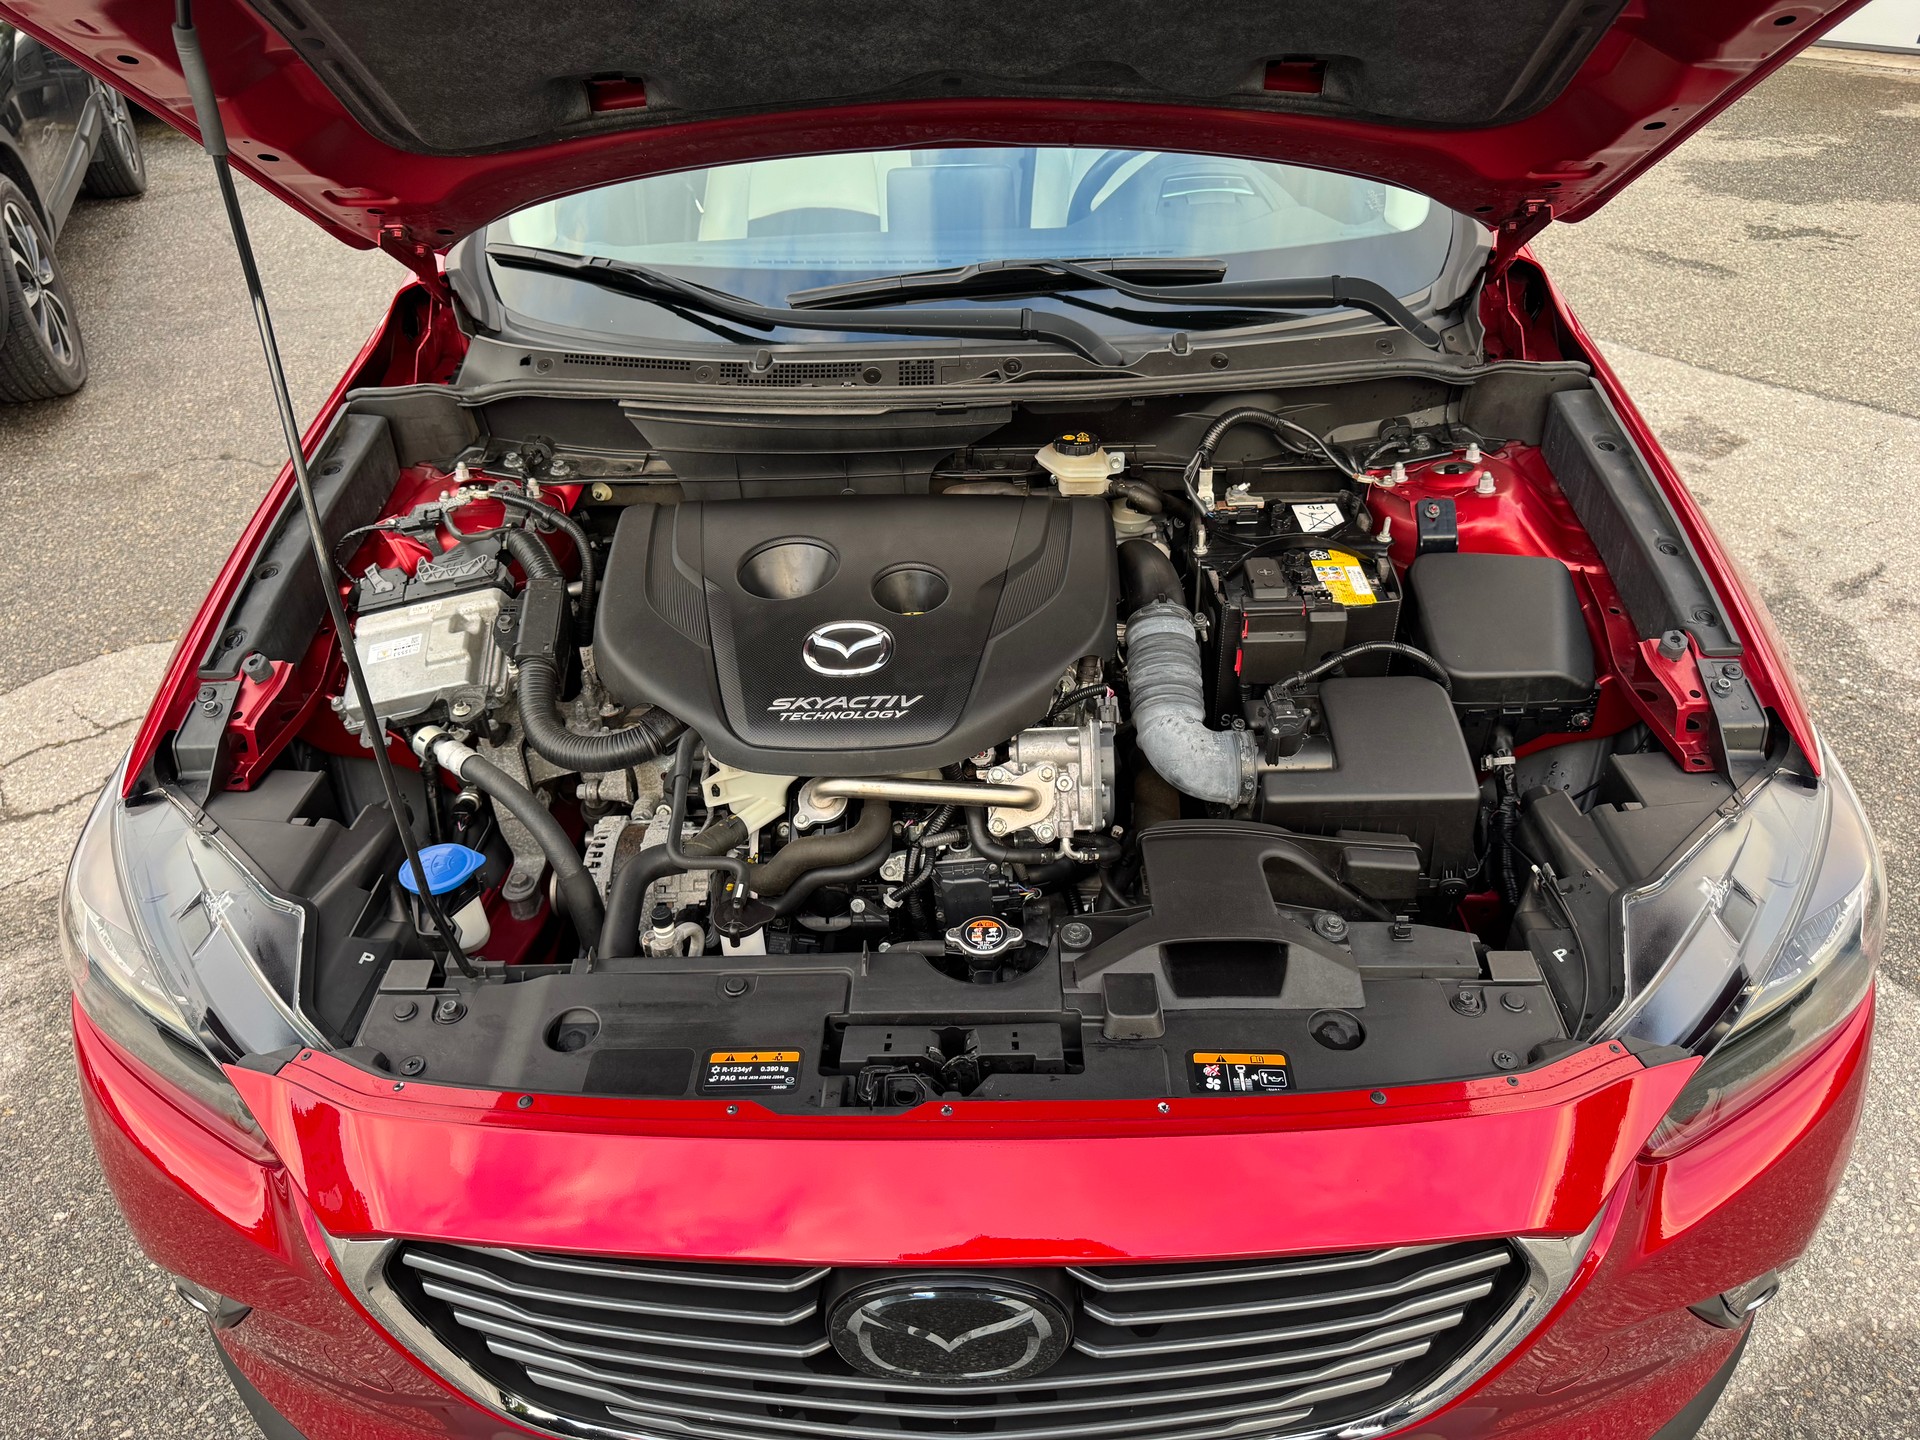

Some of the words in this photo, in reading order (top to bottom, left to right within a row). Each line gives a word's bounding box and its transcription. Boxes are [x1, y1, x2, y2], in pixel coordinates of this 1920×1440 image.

[767, 695, 924, 711] SKYACTIV
[779, 710, 909, 721] TECHNOLOGY
[358, 951, 376, 965] P
[1552, 948, 1568, 963] P
[779, 1065, 789, 1073] kg
